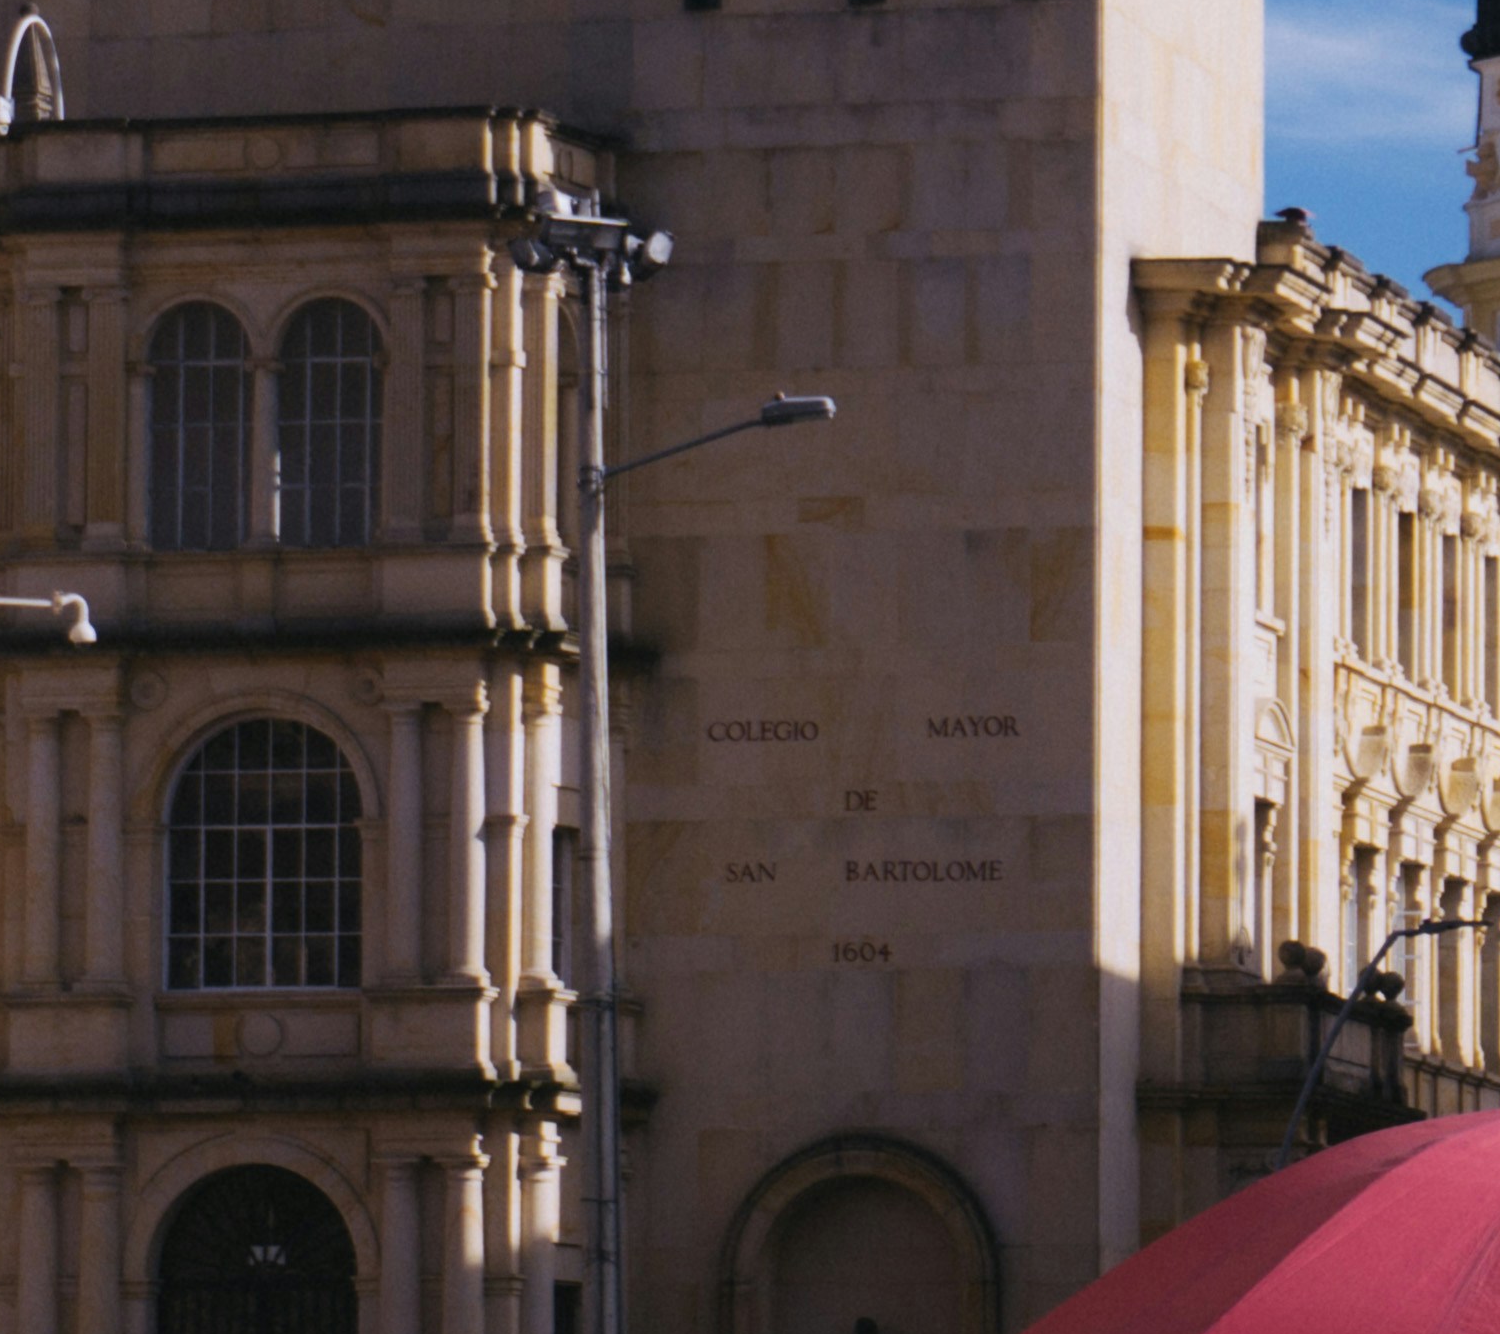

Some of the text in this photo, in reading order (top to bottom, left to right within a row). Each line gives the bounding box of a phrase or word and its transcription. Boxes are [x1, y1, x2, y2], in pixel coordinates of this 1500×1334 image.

[707, 715, 1020, 742] COLEGIO MAYOR
[844, 790, 879, 812] DE
[725, 860, 1004, 883] SAN BARTOLOME
[831, 941, 893, 963] 1604
